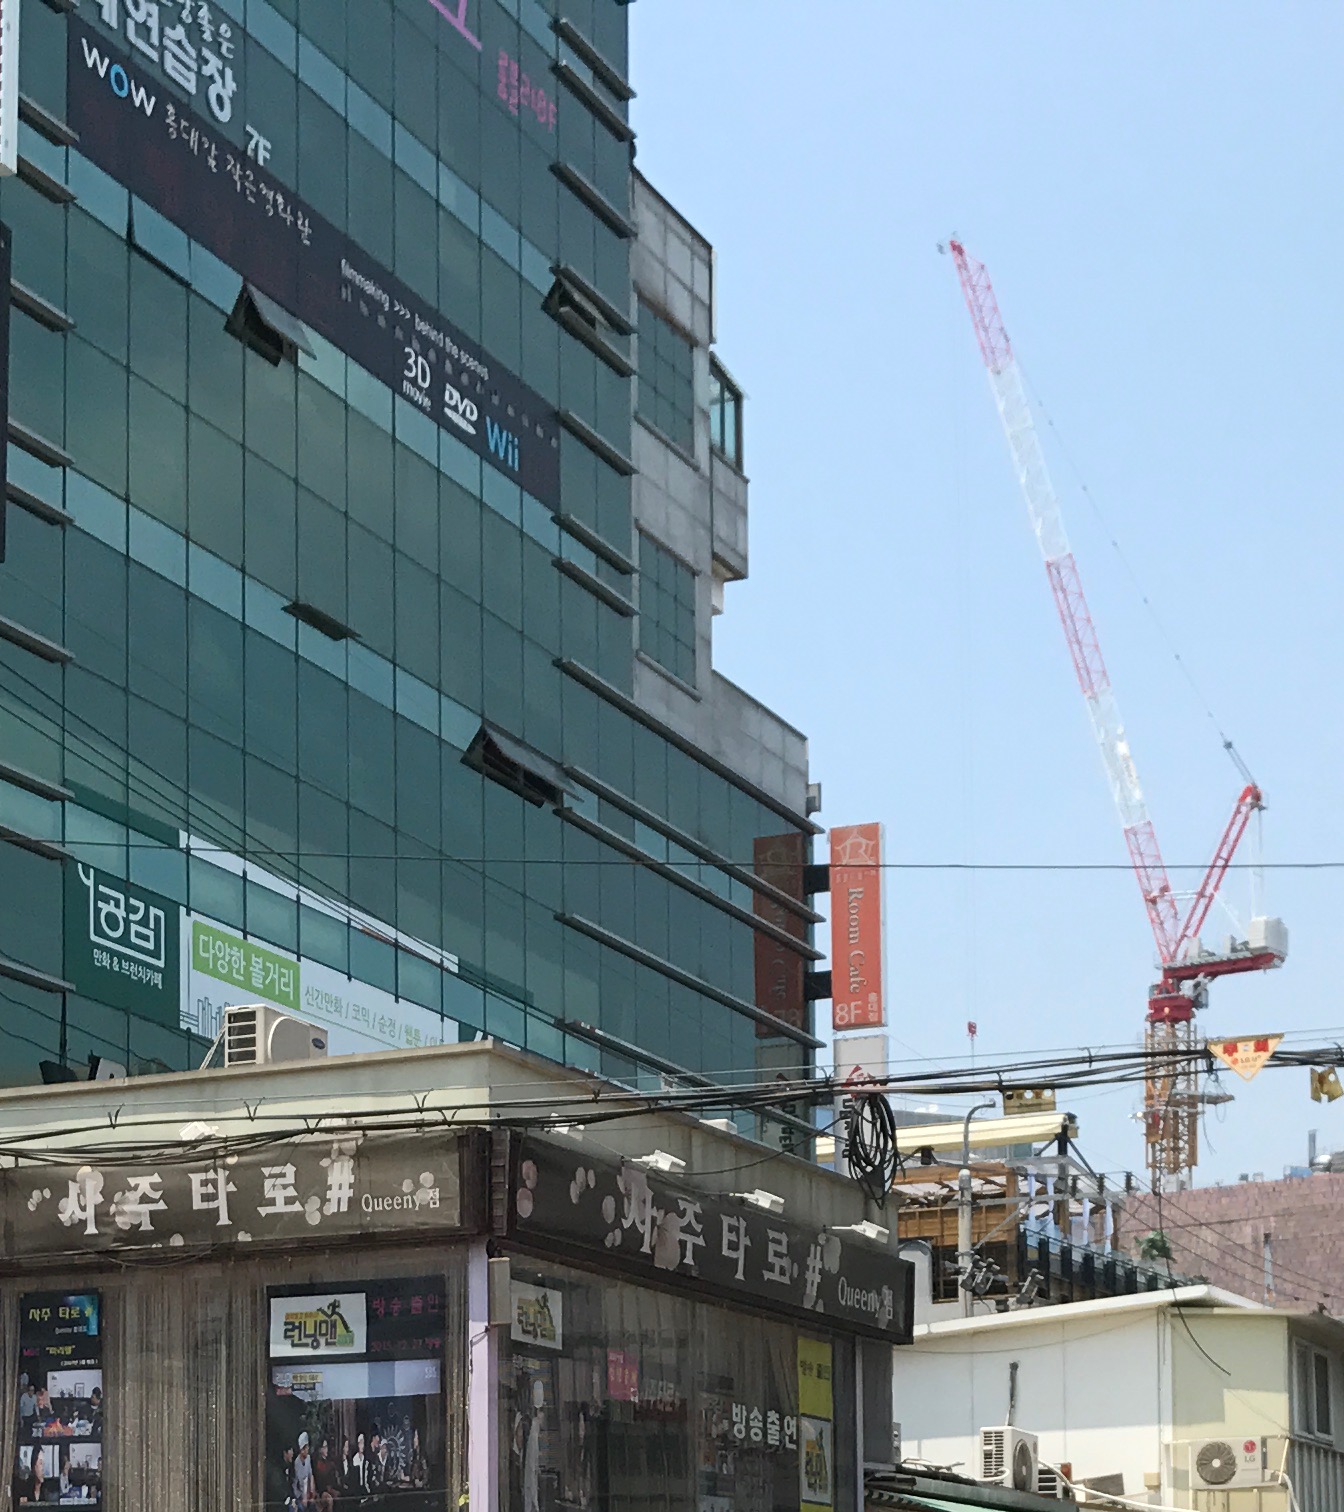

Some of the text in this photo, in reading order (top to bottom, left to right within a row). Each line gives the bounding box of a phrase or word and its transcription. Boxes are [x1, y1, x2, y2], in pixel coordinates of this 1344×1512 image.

[81, 37, 156, 117] WOW
[245, 124, 272, 167] 7F
[403, 347, 431, 388] 3D
[444, 382, 479, 422] DVD
[485, 415, 520, 472] Wii
[97, 884, 165, 951] 공감
[847, 887, 864, 945] Room
[198, 934, 295, 1001] 다양한 볼거리
[848, 949, 867, 994] Cafe
[834, 1000, 863, 1026] 8F
[361, 1191, 423, 1213] Queeny
[837, 1275, 881, 1319] Queeny
[283, 1319, 339, 1351] 런닝맨
